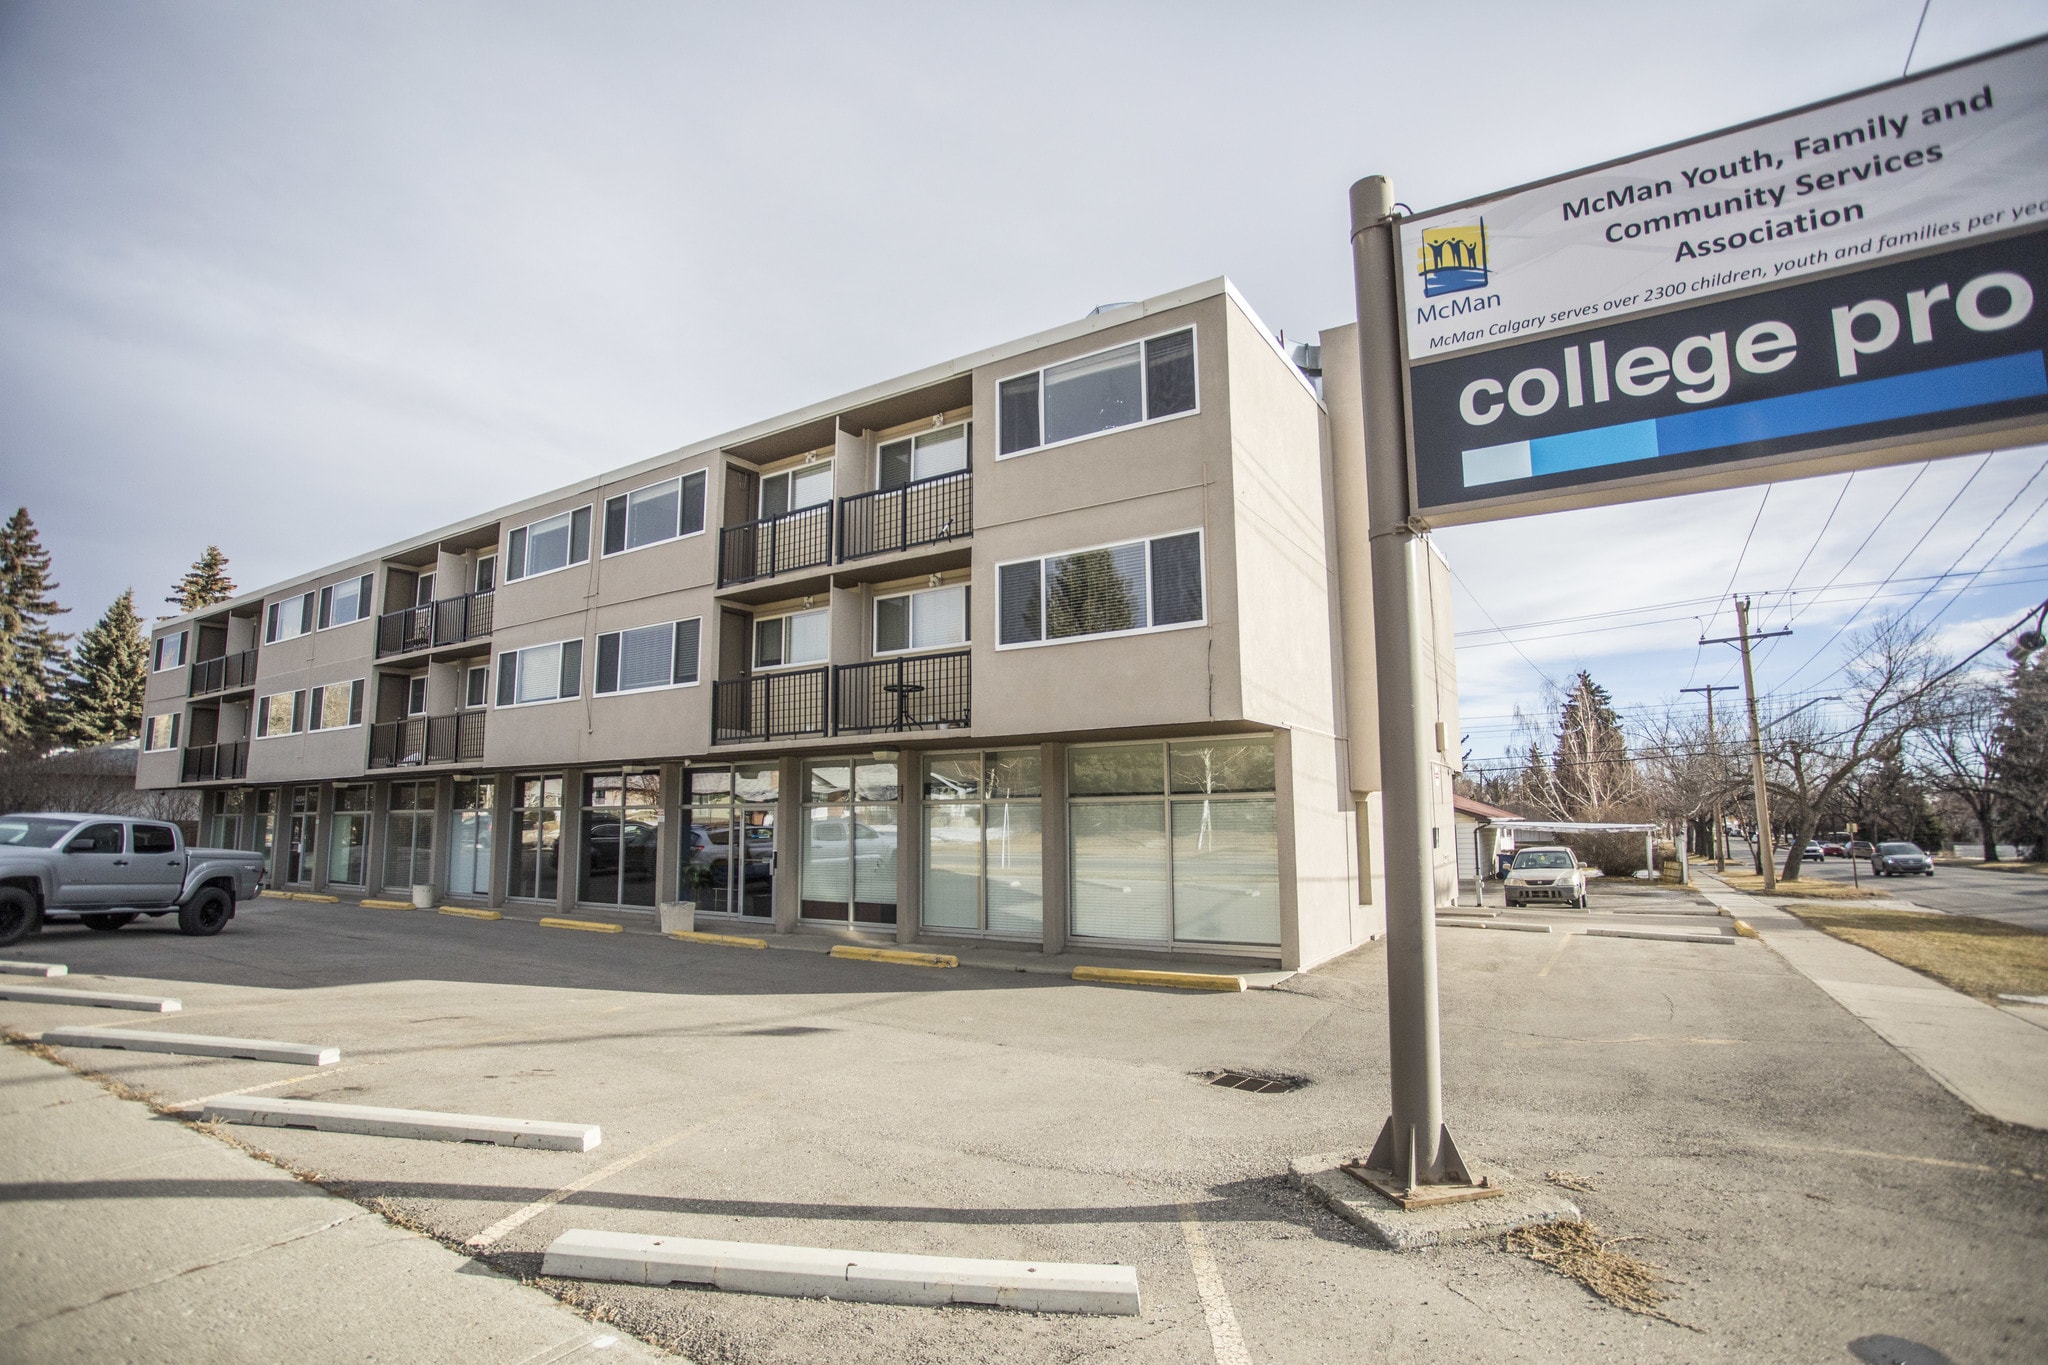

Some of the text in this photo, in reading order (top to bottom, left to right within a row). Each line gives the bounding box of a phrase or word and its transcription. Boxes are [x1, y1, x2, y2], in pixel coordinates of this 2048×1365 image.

[1562, 84, 1994, 222] McMan Youth, Family and
[1605, 143, 1944, 244] Community Services
[1429, 327, 1484, 349] McMan
[1488, 314, 1546, 337] Calgary
[1549, 303, 1599, 324] serves
[1603, 293, 1640, 312] over
[1643, 280, 1687, 303] 2300
[1691, 269, 1768, 293] children,
[1773, 250, 1828, 277] youth
[1834, 238, 1873, 260] and
[1876, 223, 1962, 254] families
[1967, 208, 2007, 233] per
[1674, 202, 1865, 263] Association
[1416, 293, 1501, 325] McMan
[1459, 271, 2035, 428] college pro
